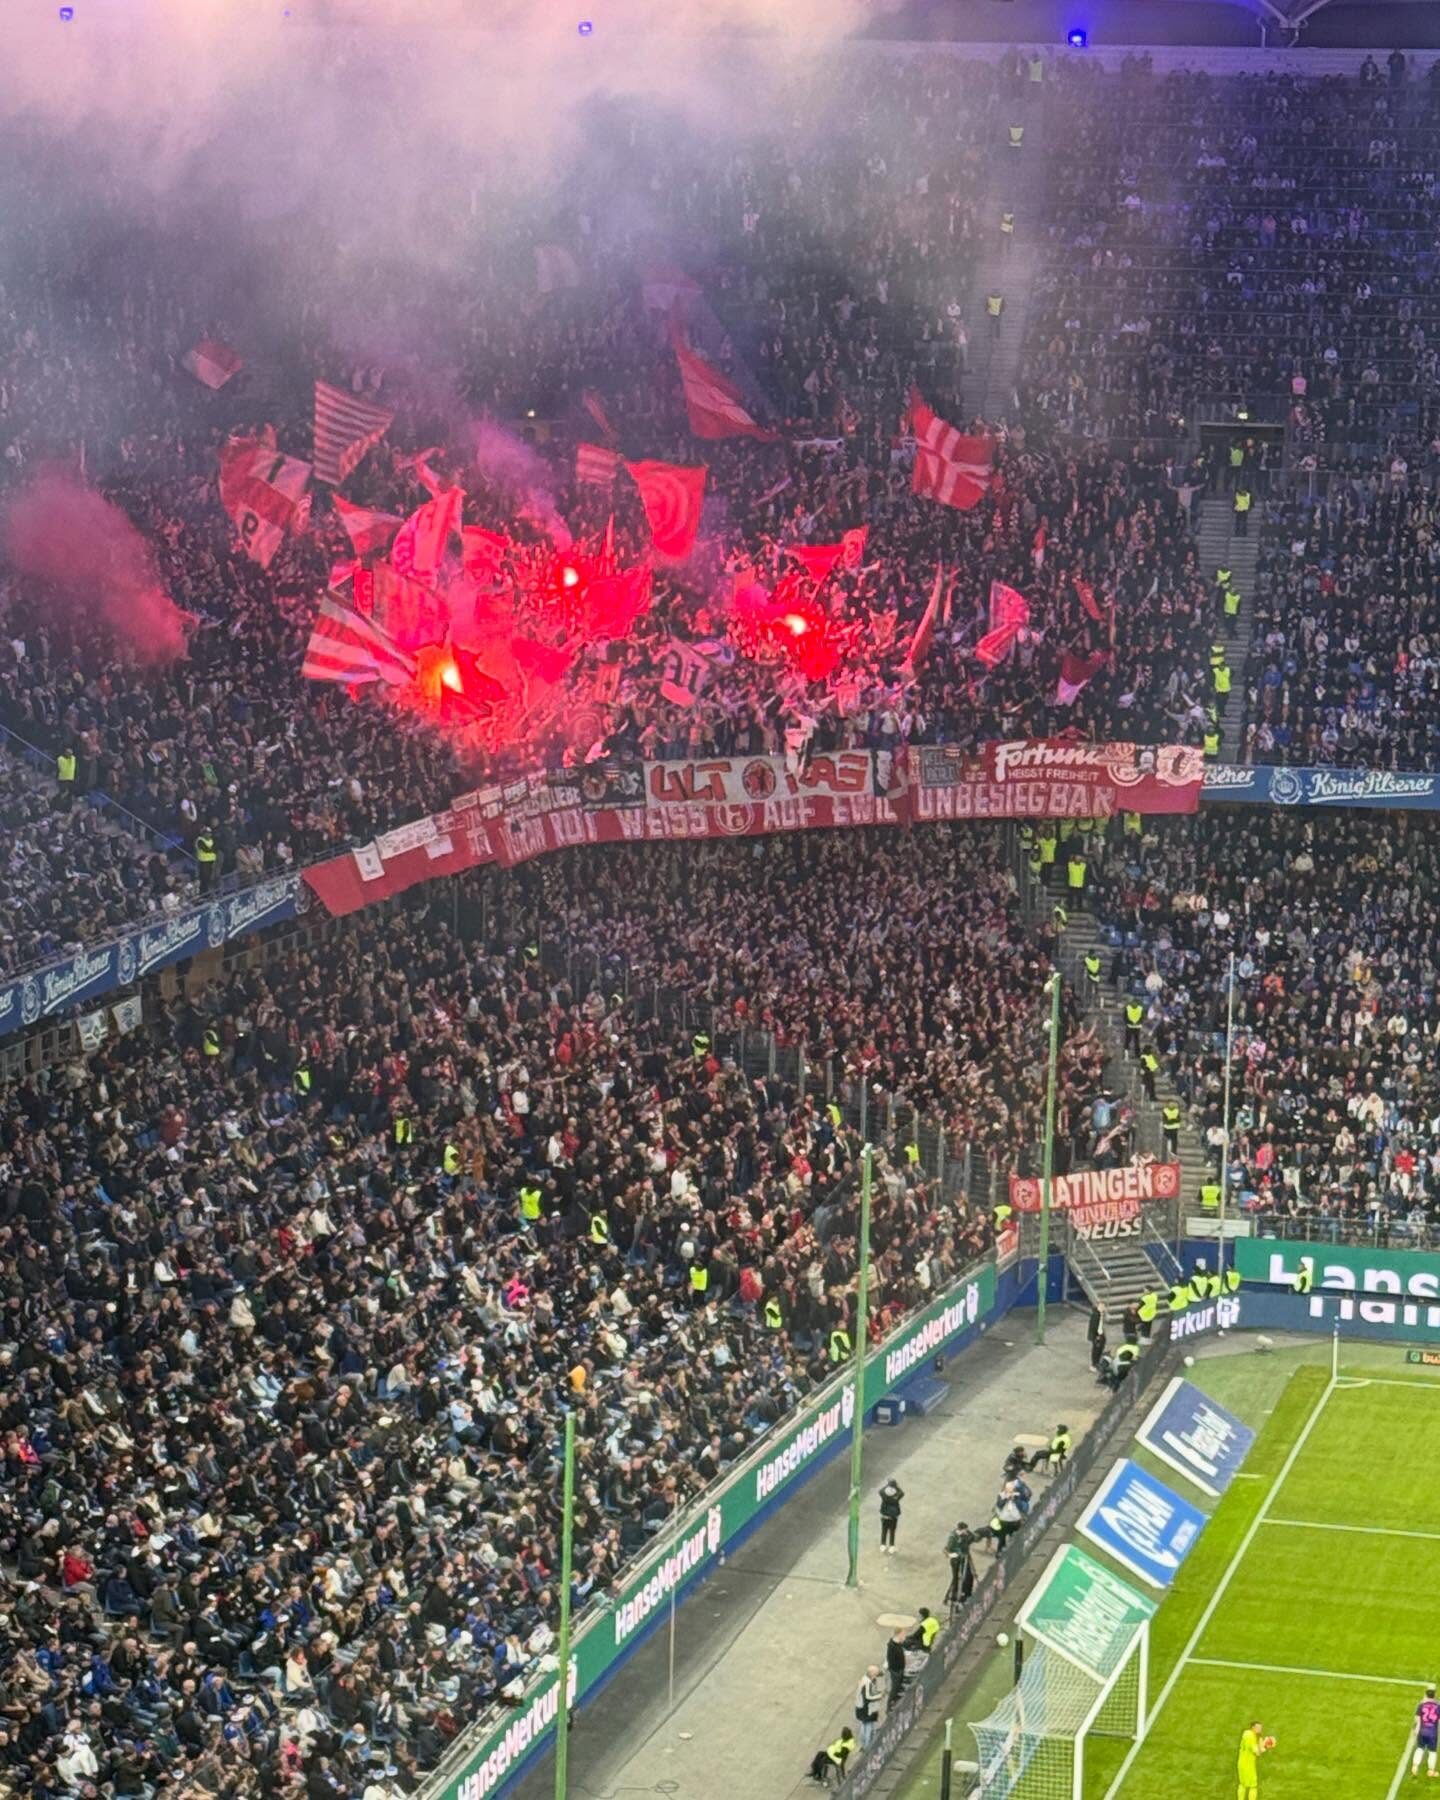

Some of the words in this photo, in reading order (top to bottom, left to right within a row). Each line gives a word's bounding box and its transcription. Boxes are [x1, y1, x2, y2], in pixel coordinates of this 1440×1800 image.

[1308, 772, 1364, 798] König
[1364, 771, 1434, 793] Pilsener
[1075, 1216, 1143, 1241] NEUSS
[886, 1299, 966, 1384] HanseMerkur
[756, 1402, 841, 1502] HanseMerkur
[615, 1526, 707, 1645] HanseMerkur
